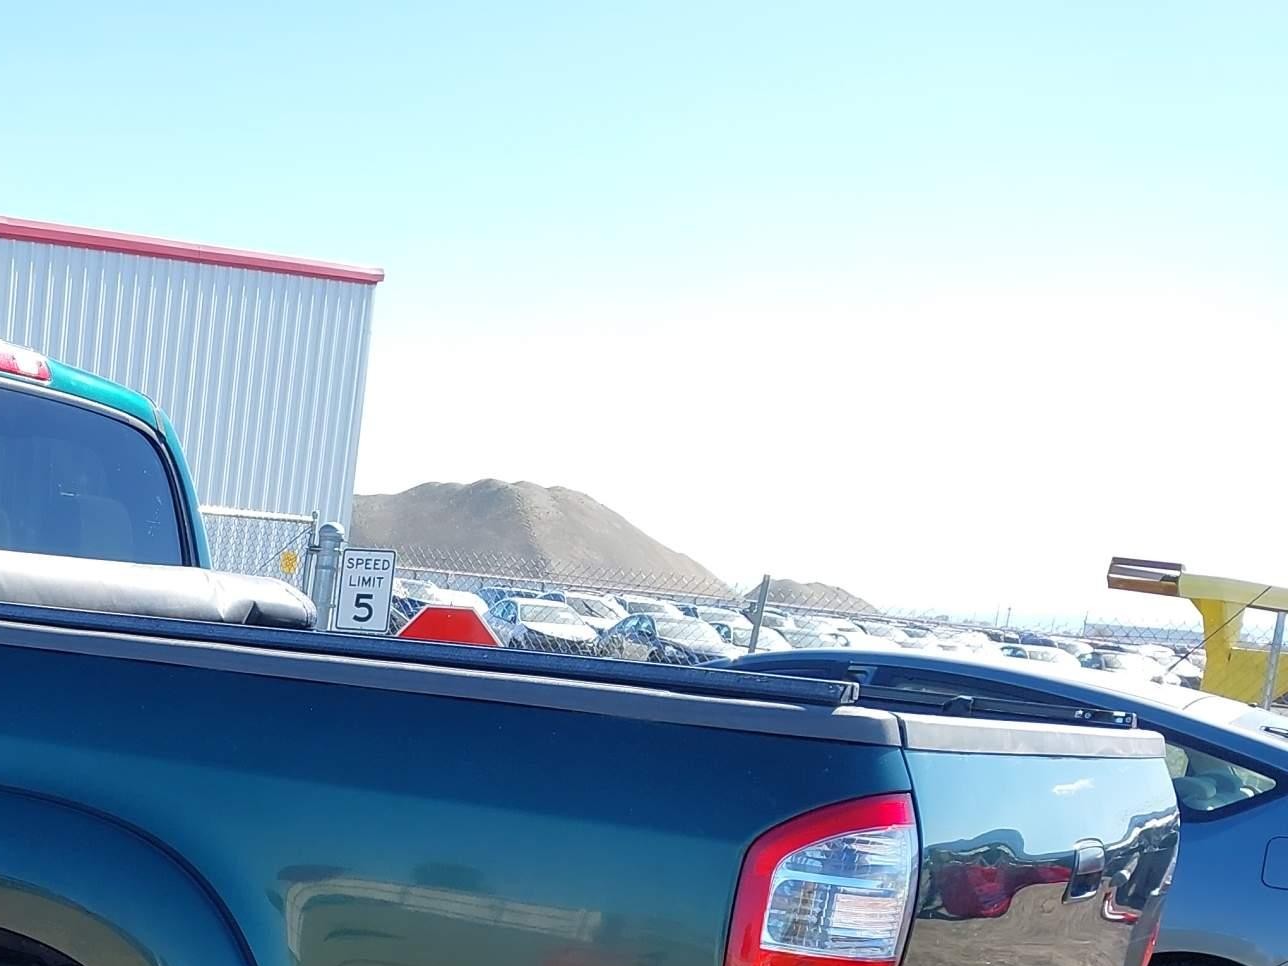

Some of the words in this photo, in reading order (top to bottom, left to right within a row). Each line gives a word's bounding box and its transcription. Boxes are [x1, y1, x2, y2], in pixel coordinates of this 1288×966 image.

[346, 557, 391, 571] SPEED
[348, 575, 385, 588] LIMIT
[352, 593, 374, 622] 5
